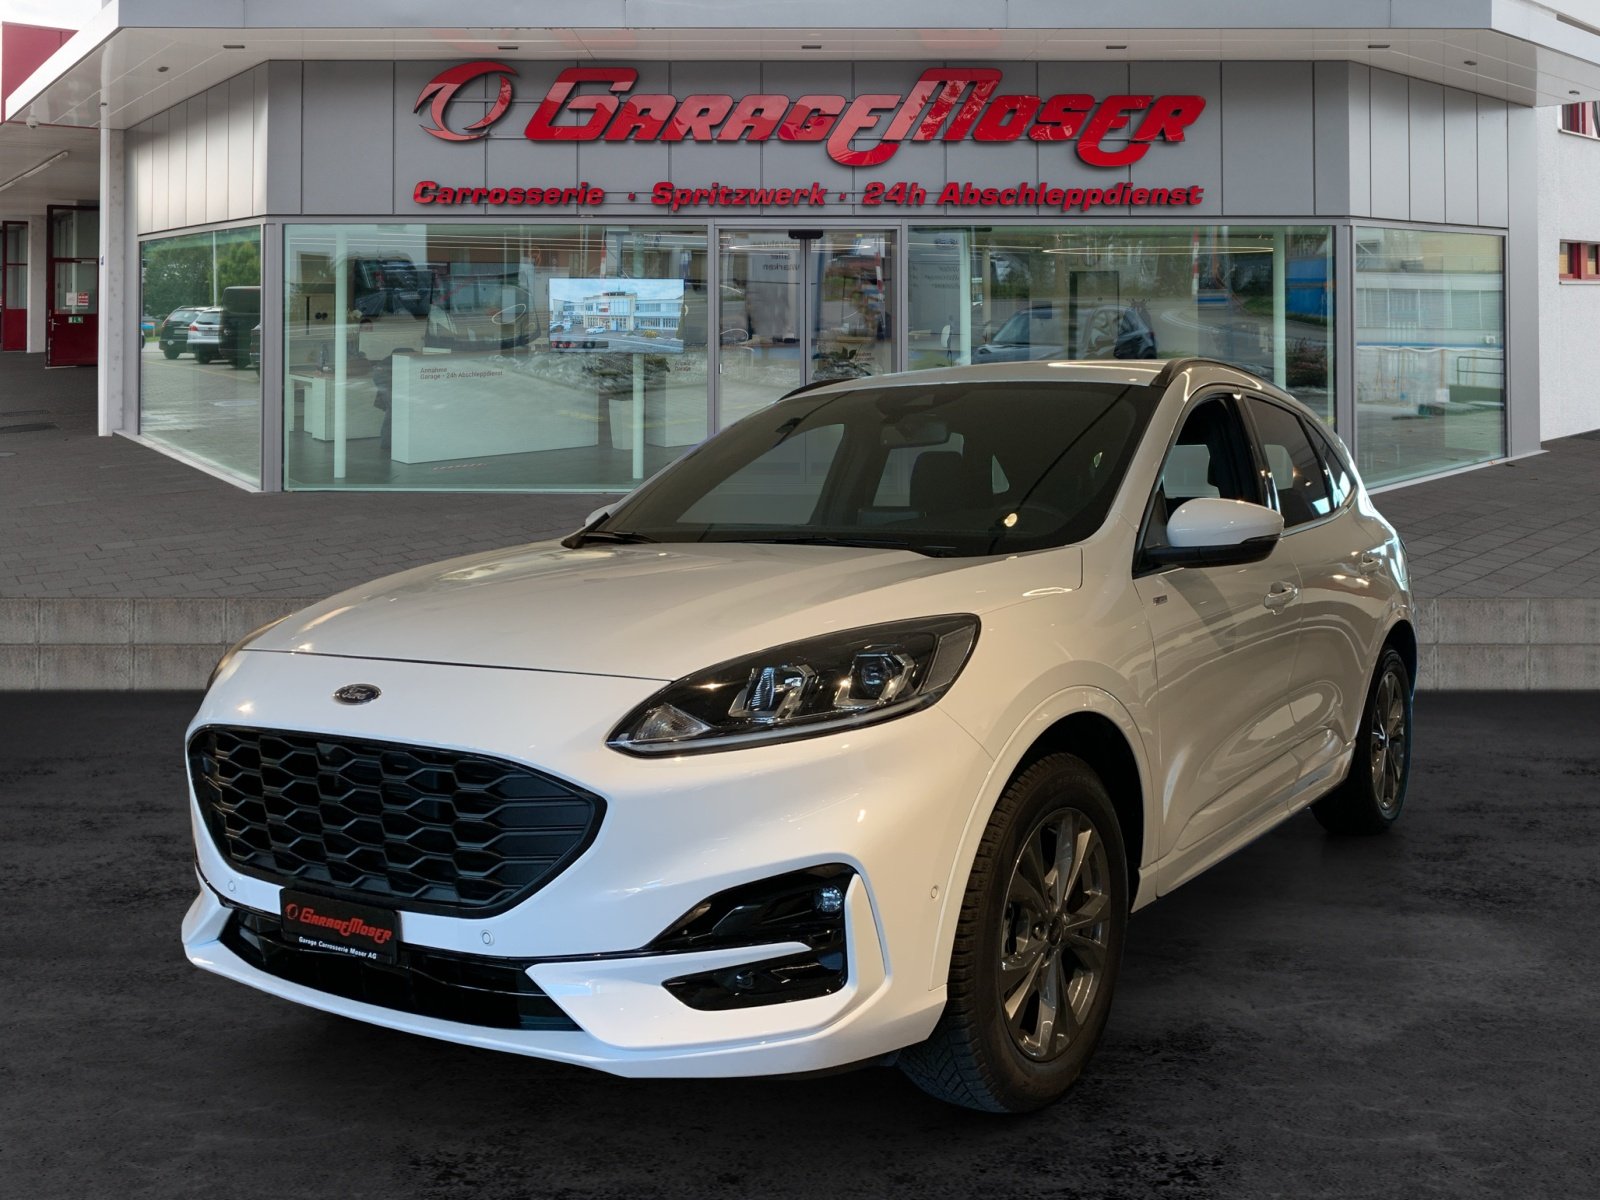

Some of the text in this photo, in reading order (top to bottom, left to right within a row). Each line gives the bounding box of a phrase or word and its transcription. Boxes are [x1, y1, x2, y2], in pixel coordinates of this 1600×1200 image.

[413, 181, 1203, 211] Carrosserie Spritzwerk 24h Abschleppdienst
[299, 936, 317, 946] Garage
[319, 941, 348, 953] Carrosserie
[349, 948, 367, 957] Moser
